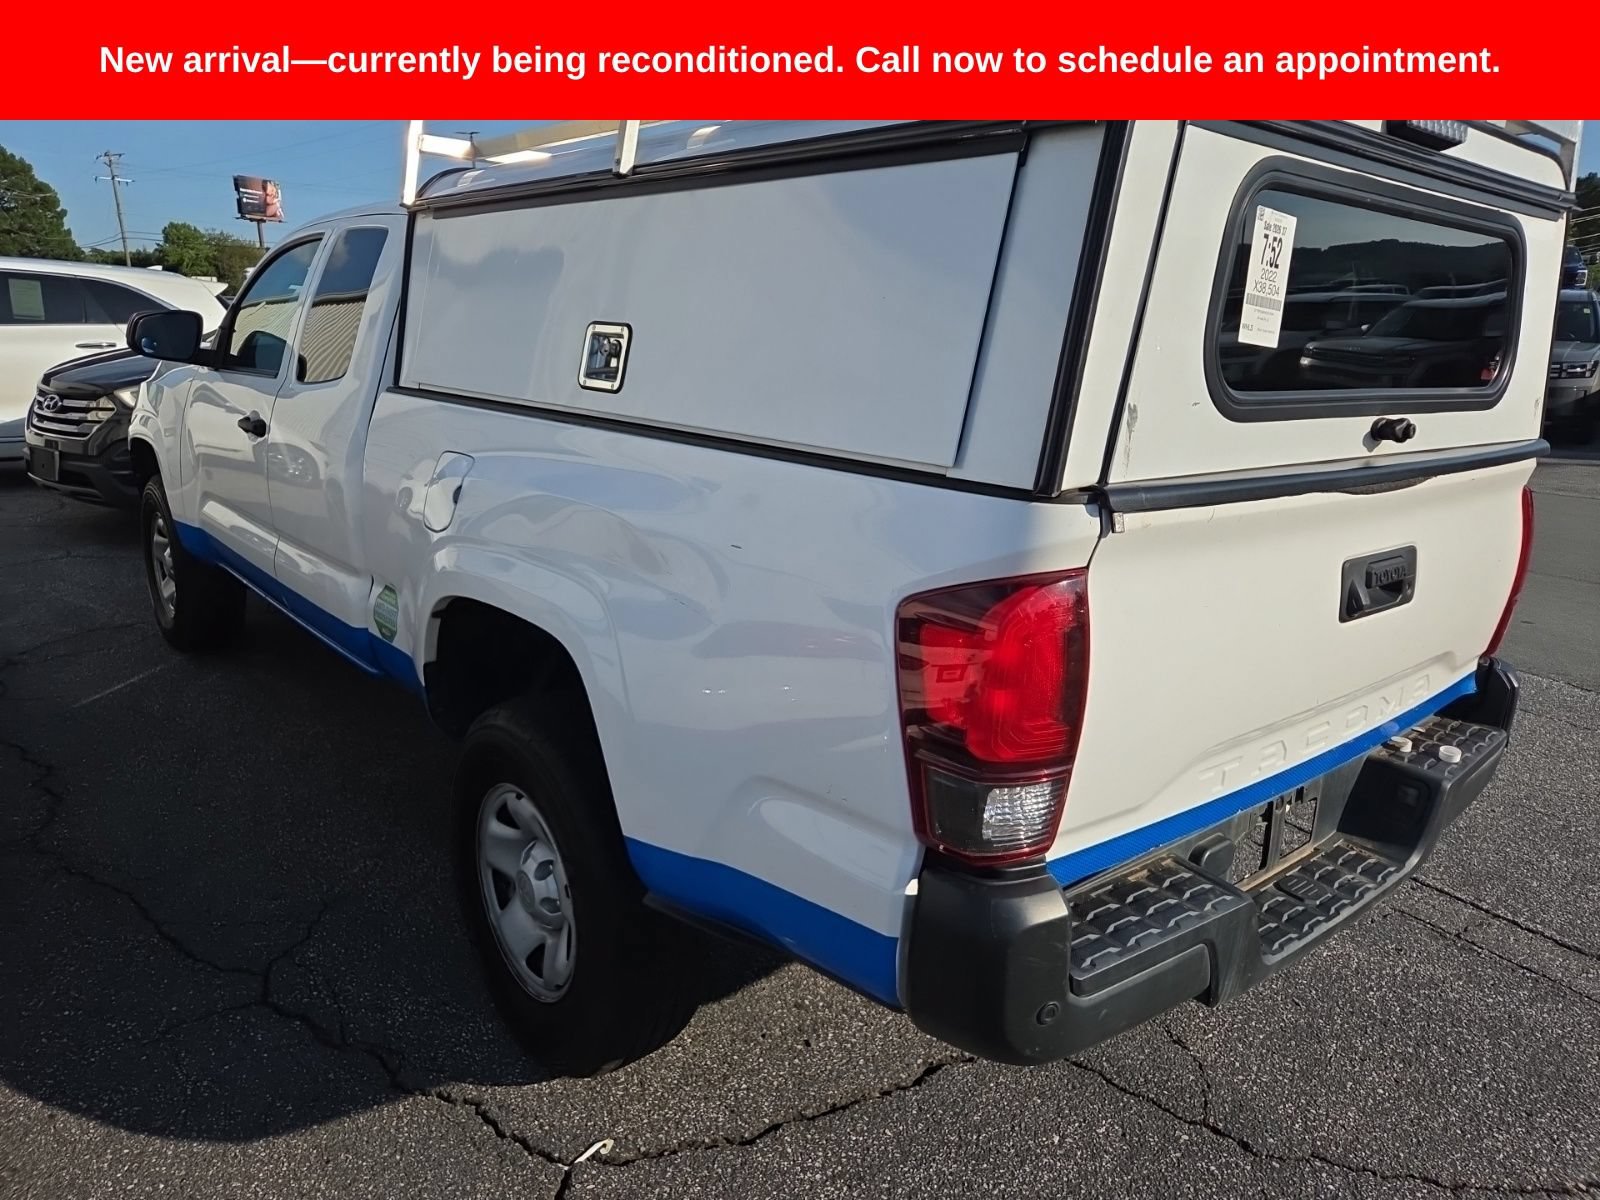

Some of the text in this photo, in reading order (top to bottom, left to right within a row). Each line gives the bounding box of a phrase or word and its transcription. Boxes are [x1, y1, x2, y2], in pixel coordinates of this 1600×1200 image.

[1261, 233, 1283, 269] 7:52
[1261, 268, 1278, 283] 2022
[1253, 279, 1280, 297] X38,504
[1373, 565, 1408, 586] TOYOTA
[1198, 673, 1432, 795] TACOMA
